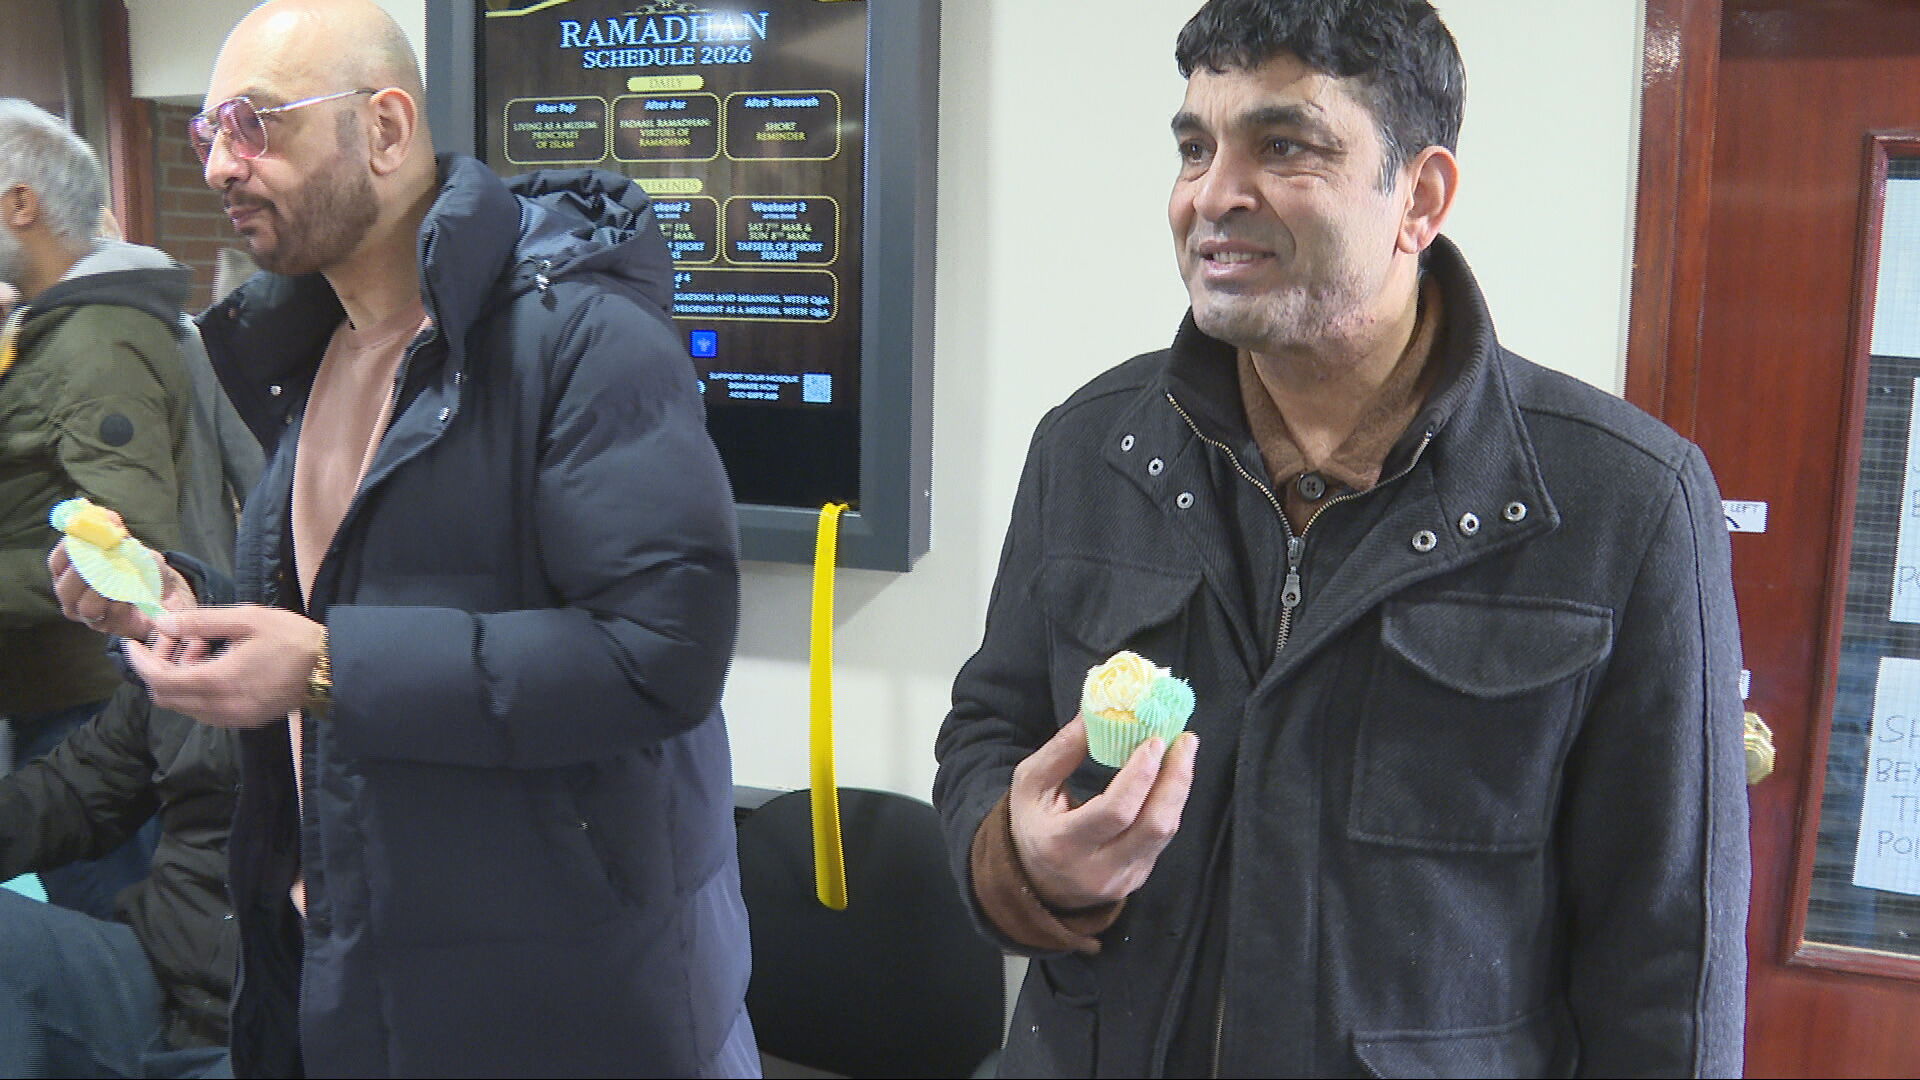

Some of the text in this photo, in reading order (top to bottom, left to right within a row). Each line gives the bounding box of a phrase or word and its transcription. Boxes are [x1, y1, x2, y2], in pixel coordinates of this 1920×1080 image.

[559, 11, 769, 48] RAMADHAN
[583, 44, 753, 69] SCHEDULE 2026
[649, 78, 682, 90] DAILY
[643, 99, 687, 111] After Asr
[743, 96, 820, 108] After Taraweeh
[534, 103, 578, 115] After Fajr
[765, 122, 797, 131] SHORT
[640, 128, 690, 137] VIRTUES OF
[755, 132, 806, 141] REMINDER
[639, 137, 691, 147] RAMADHAN
[683, 202, 691, 213] 2
[751, 202, 807, 213] Weekend 3
[748, 222, 763, 232] SAT
[781, 222, 803, 232] MAR
[804, 223, 813, 232] &
[748, 232, 769, 241] SUN
[674, 241, 705, 251] SHORT
[736, 241, 824, 253] TAFSEER OF SHORT
[760, 250, 799, 261] SURAHS
[683, 272, 692, 283] 4
[716, 294, 737, 303] AND
[783, 294, 809, 305] WITH
[809, 295, 830, 306] Q&A
[725, 305, 737, 314] AS
[737, 305, 745, 314] A
[783, 306, 808, 317] WITH
[809, 307, 829, 318] Q&A
[708, 371, 800, 384] SUPPORT YOUR MOSQUE
[728, 381, 780, 392] DONATE NOW
[1730, 503, 1761, 513] LEFT
